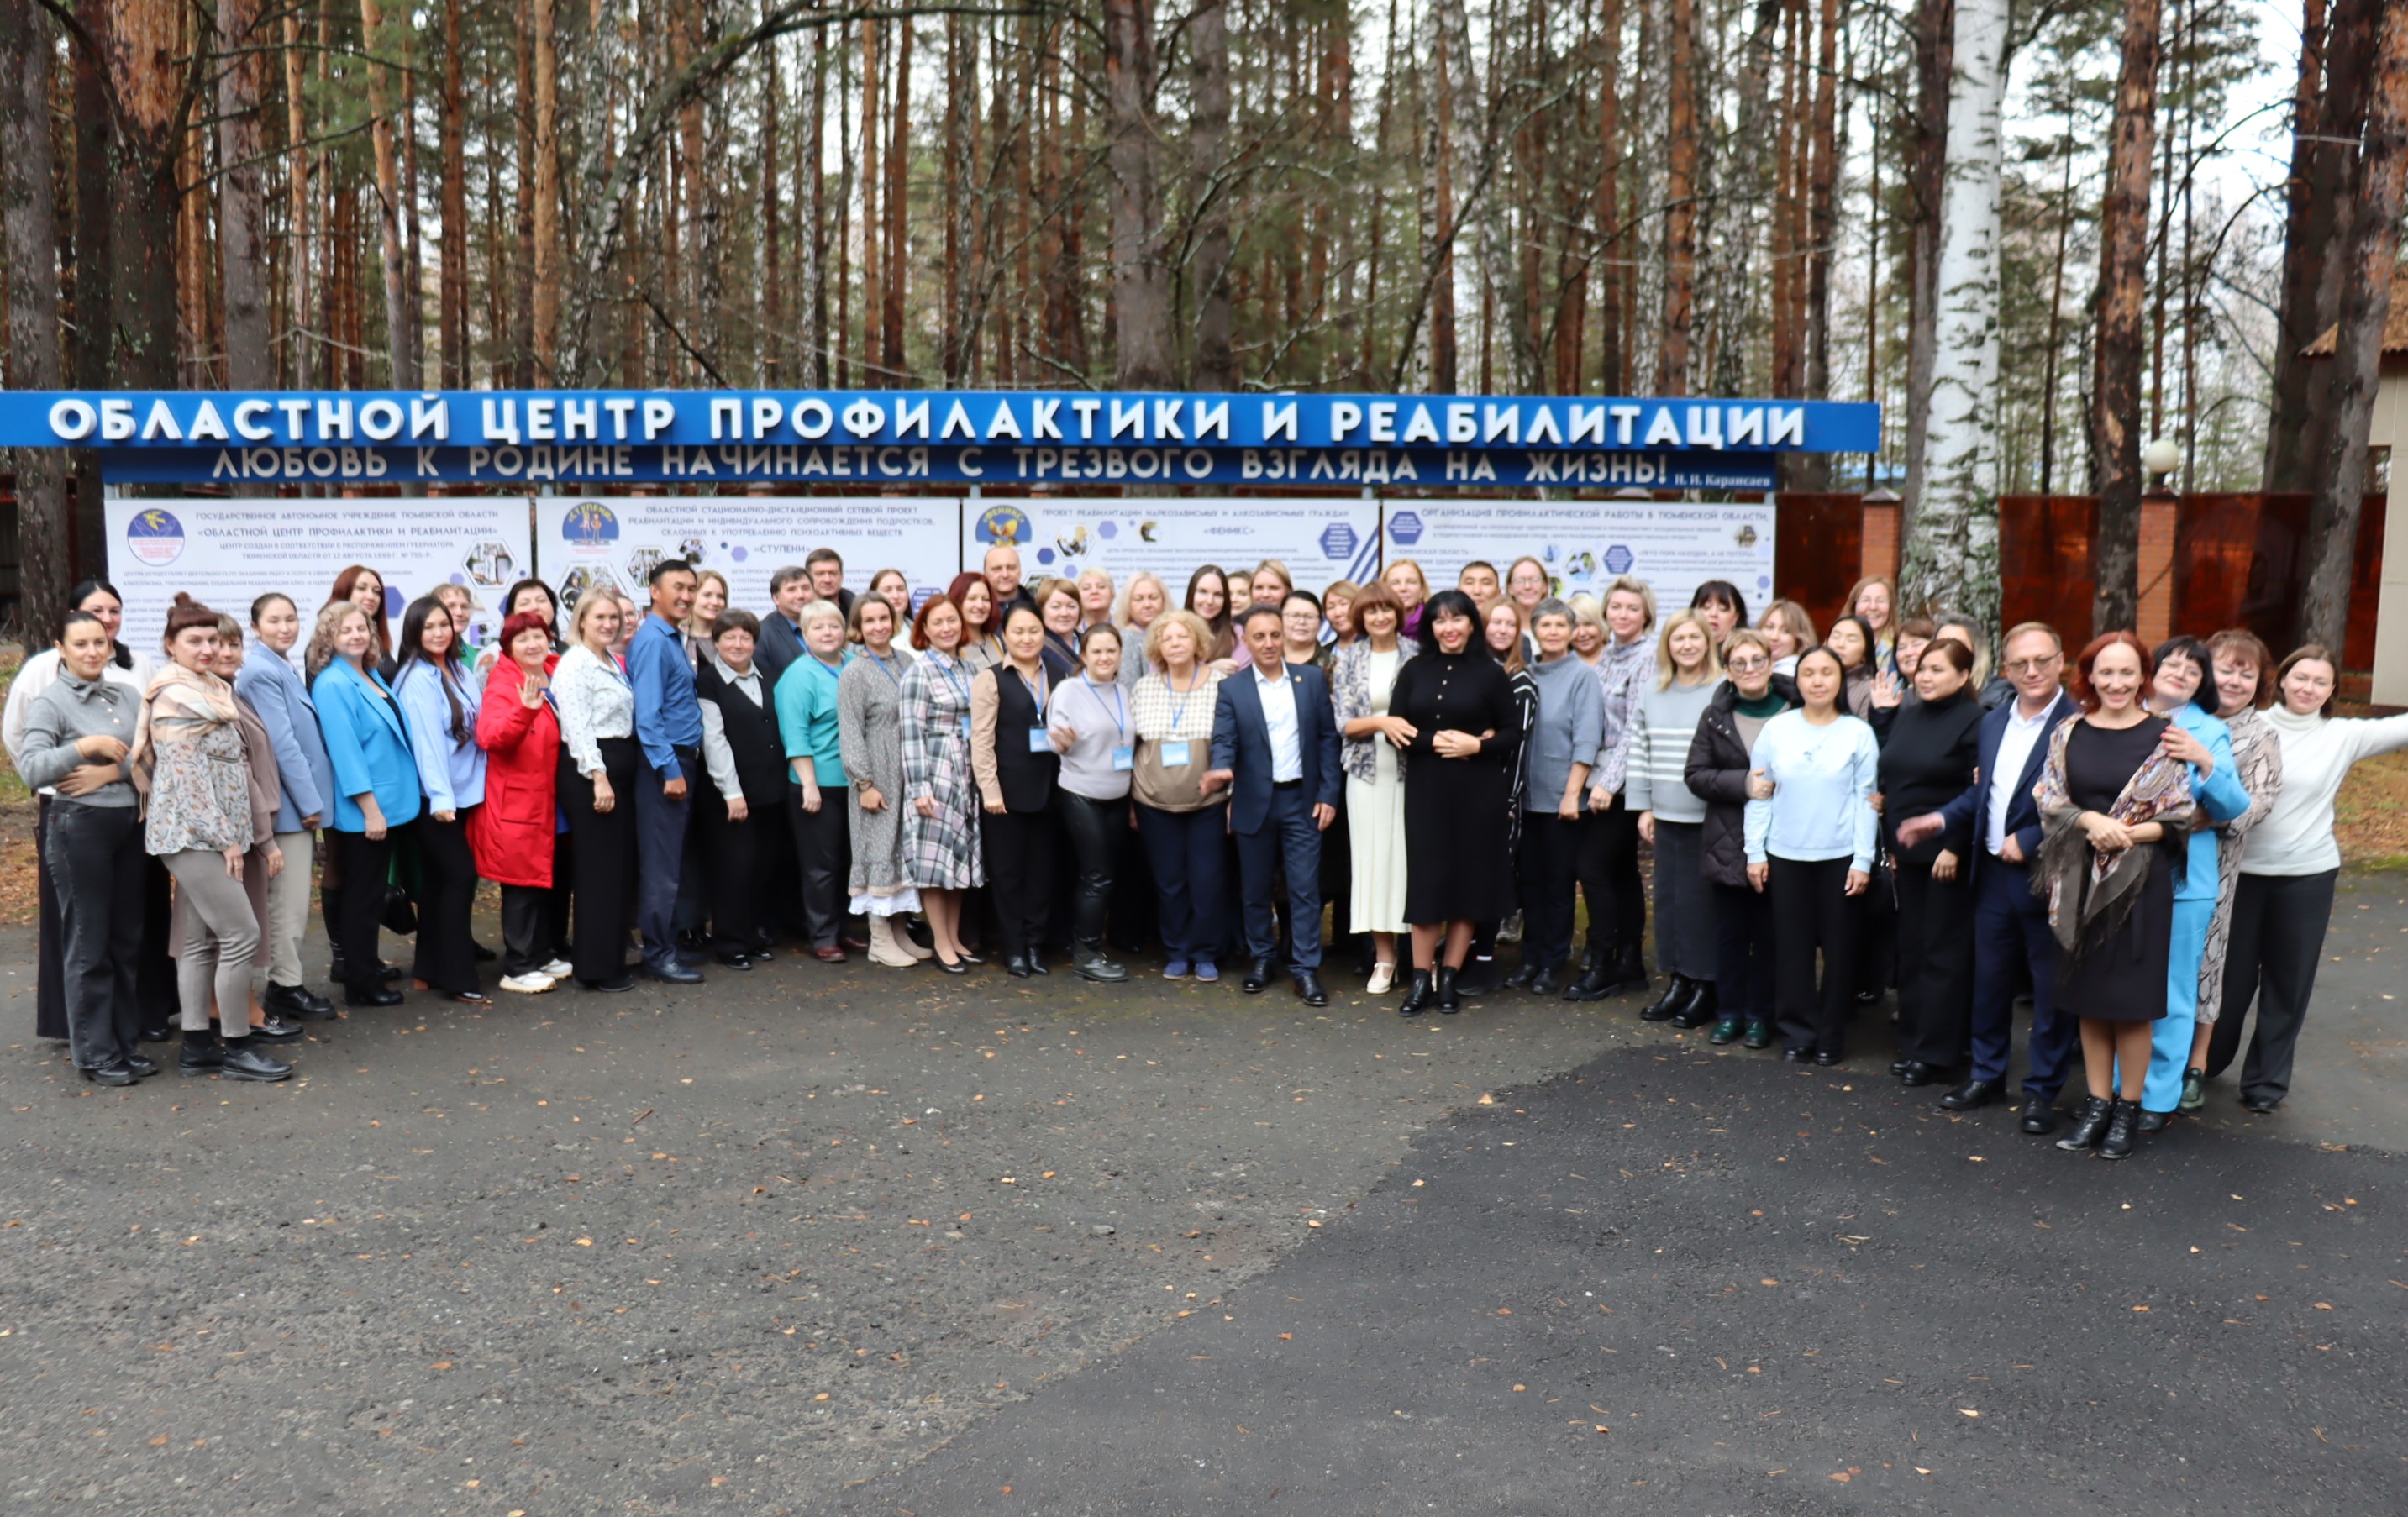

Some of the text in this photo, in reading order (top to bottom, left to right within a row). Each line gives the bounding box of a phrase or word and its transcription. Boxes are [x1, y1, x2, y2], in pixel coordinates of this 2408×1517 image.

[49, 393, 1804, 450] ОБЛАСТНОЙ ЦЕНТР ПРОФИЛАКТИКИ И РЕАБИЛИТАЦИИ
[213, 447, 1668, 484] ЛЮБОВЬ К РОДИНЕ НАЧИНАЕТСЯ С ТРЕЗВОГО ВЗГЛЯДА НА ЖИЗНЬ!
[196, 509, 499, 522] ГОСУДАРСТВЕННОЕ АВТОНОМНОЕ УЧРЕЖДЕНИЕ ТЮМЕНСКОЙ ОБЛАСТИ
[645, 505, 917, 515] ОБЛАСТНОЙ СТАЦИОНАРНО-ДИСТАНЦИОННЫЙ СЕТЕВОЙ ПРОЕКТ
[1043, 509, 1073, 517] ПРОЕКТ
[1077, 509, 1142, 517] РЕАБИЛИТАЦИИ
[1308, 509, 1349, 517] ГРАЖДАН
[1421, 508, 1491, 518] ОРГАНИЗАЦИЯ
[1496, 508, 1600, 518] ПРОФИЛАКТИЧЕСКОЙ
[1604, 510, 1643, 520] РАБОТЫ
[1658, 511, 1718, 521] ТЮМЕНСКОЙ
[628, 517, 695, 525] РЕАБИЛИТАЦИИ
[707, 517, 793, 526] ИНДИВИДУАЛЬНОГО
[797, 517, 872, 527] СОПРОВОЖДЕНИЯ
[877, 517, 936, 527] ПОДРОСТКОВ,
[197, 526, 498, 538] «ОБЛАСТНОЙ ЦЕНТР ПРОФИЛАКТИКИ И РЕАБИЛИТАЦИИ»
[661, 528, 903, 538] СКЛОННЫХ К УПОТРЕБЛЕНИЮ ПСИХОАКТИВНЫХ ВЕЩЕСТВ
[754, 544, 812, 554] «СТУПЕНИ»
